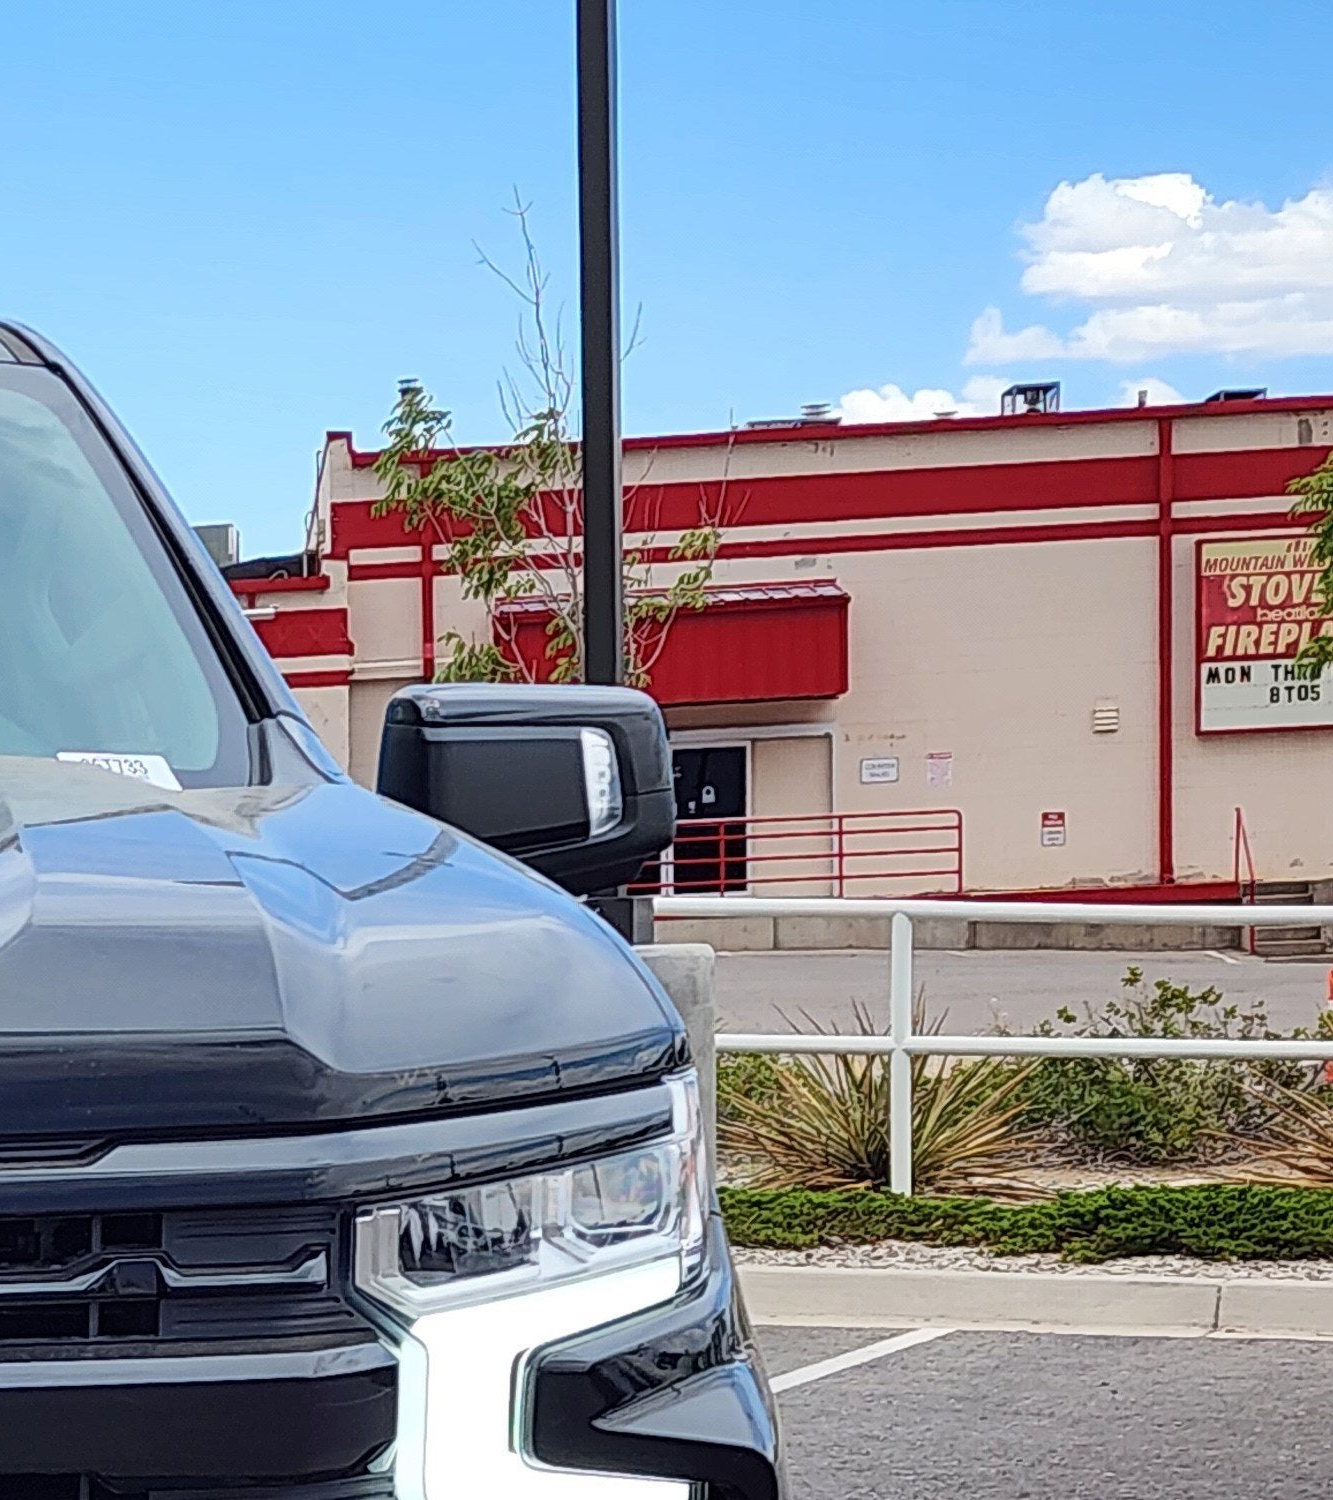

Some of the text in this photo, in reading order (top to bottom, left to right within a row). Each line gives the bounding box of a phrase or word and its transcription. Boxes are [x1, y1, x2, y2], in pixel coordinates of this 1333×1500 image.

[1204, 555, 1287, 573] MOUNTAIN
[1227, 573, 1329, 607] STOVE
[1206, 665, 1252, 684] MON
